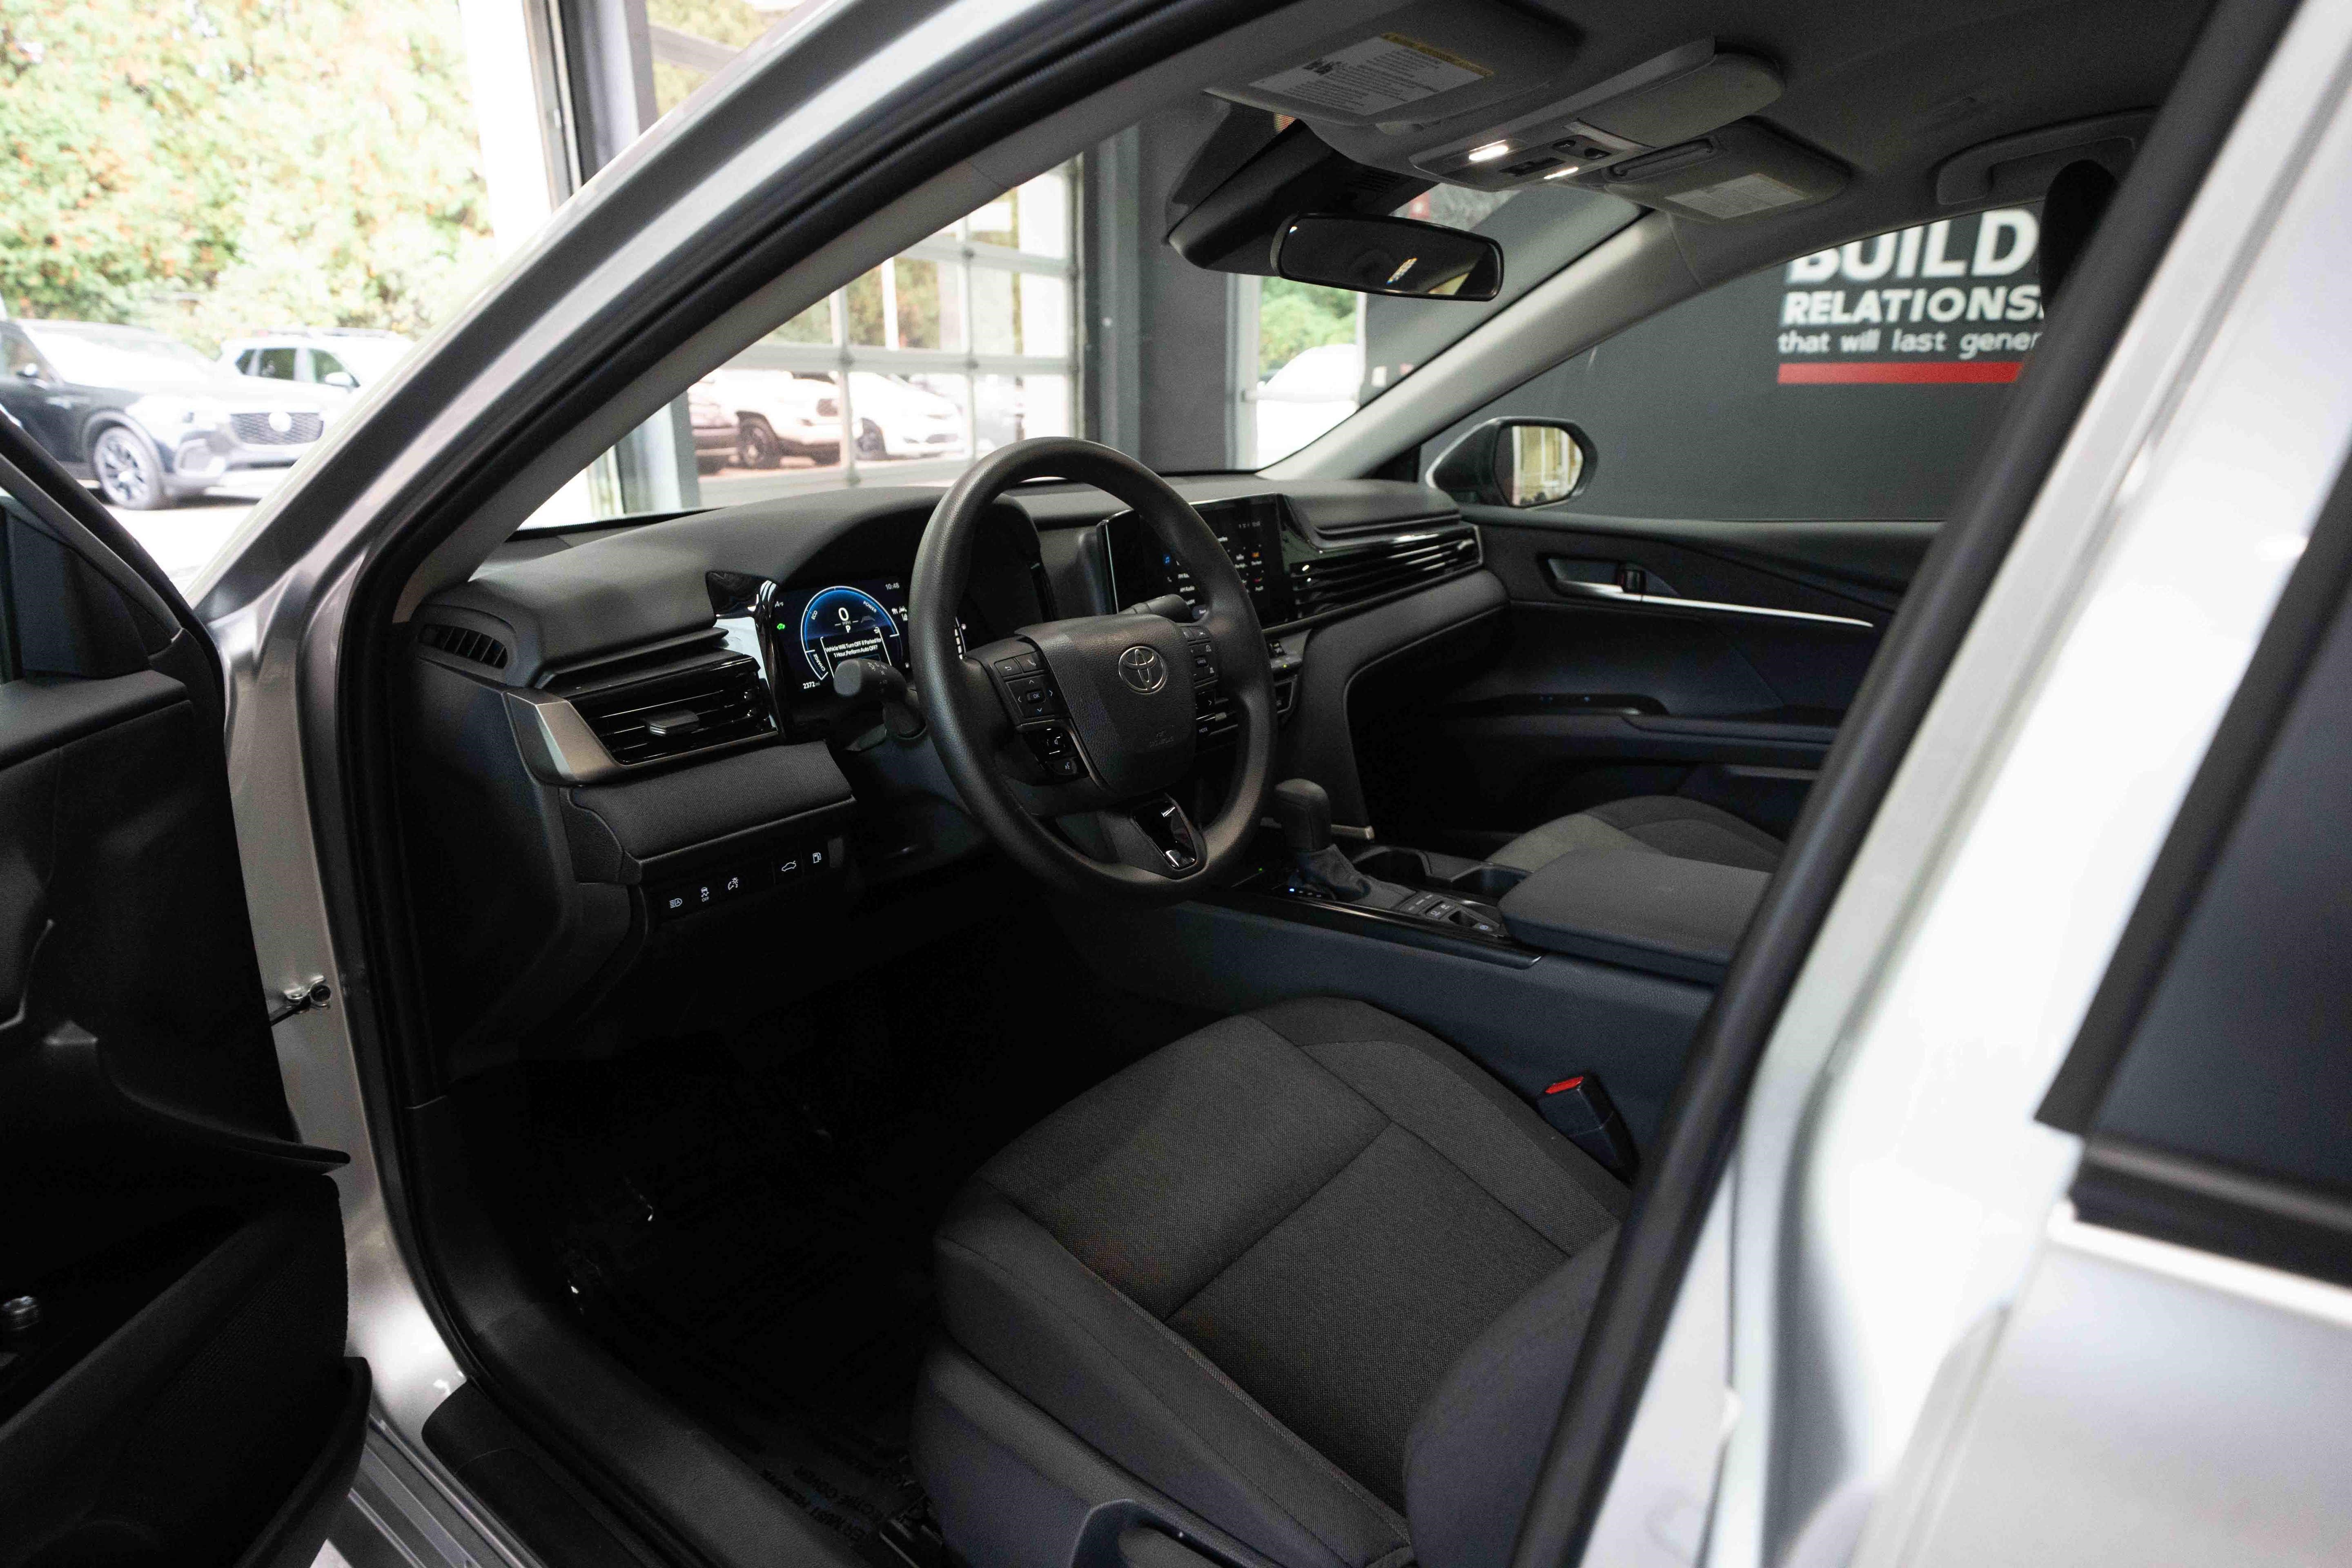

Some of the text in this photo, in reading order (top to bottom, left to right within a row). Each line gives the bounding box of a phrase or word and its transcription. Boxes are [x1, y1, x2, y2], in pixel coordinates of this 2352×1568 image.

[1782, 285, 2044, 325] RELATIONS
[1777, 330, 1831, 353] that
[1840, 329, 1880, 352] will
[1891, 328, 1948, 352] last
[863, 600, 877, 613] POWER
[838, 607, 849, 621] 0
[845, 625, 851, 633] P
[825, 644, 839, 653] Vehicle
[813, 653, 825, 671] CHARGE
